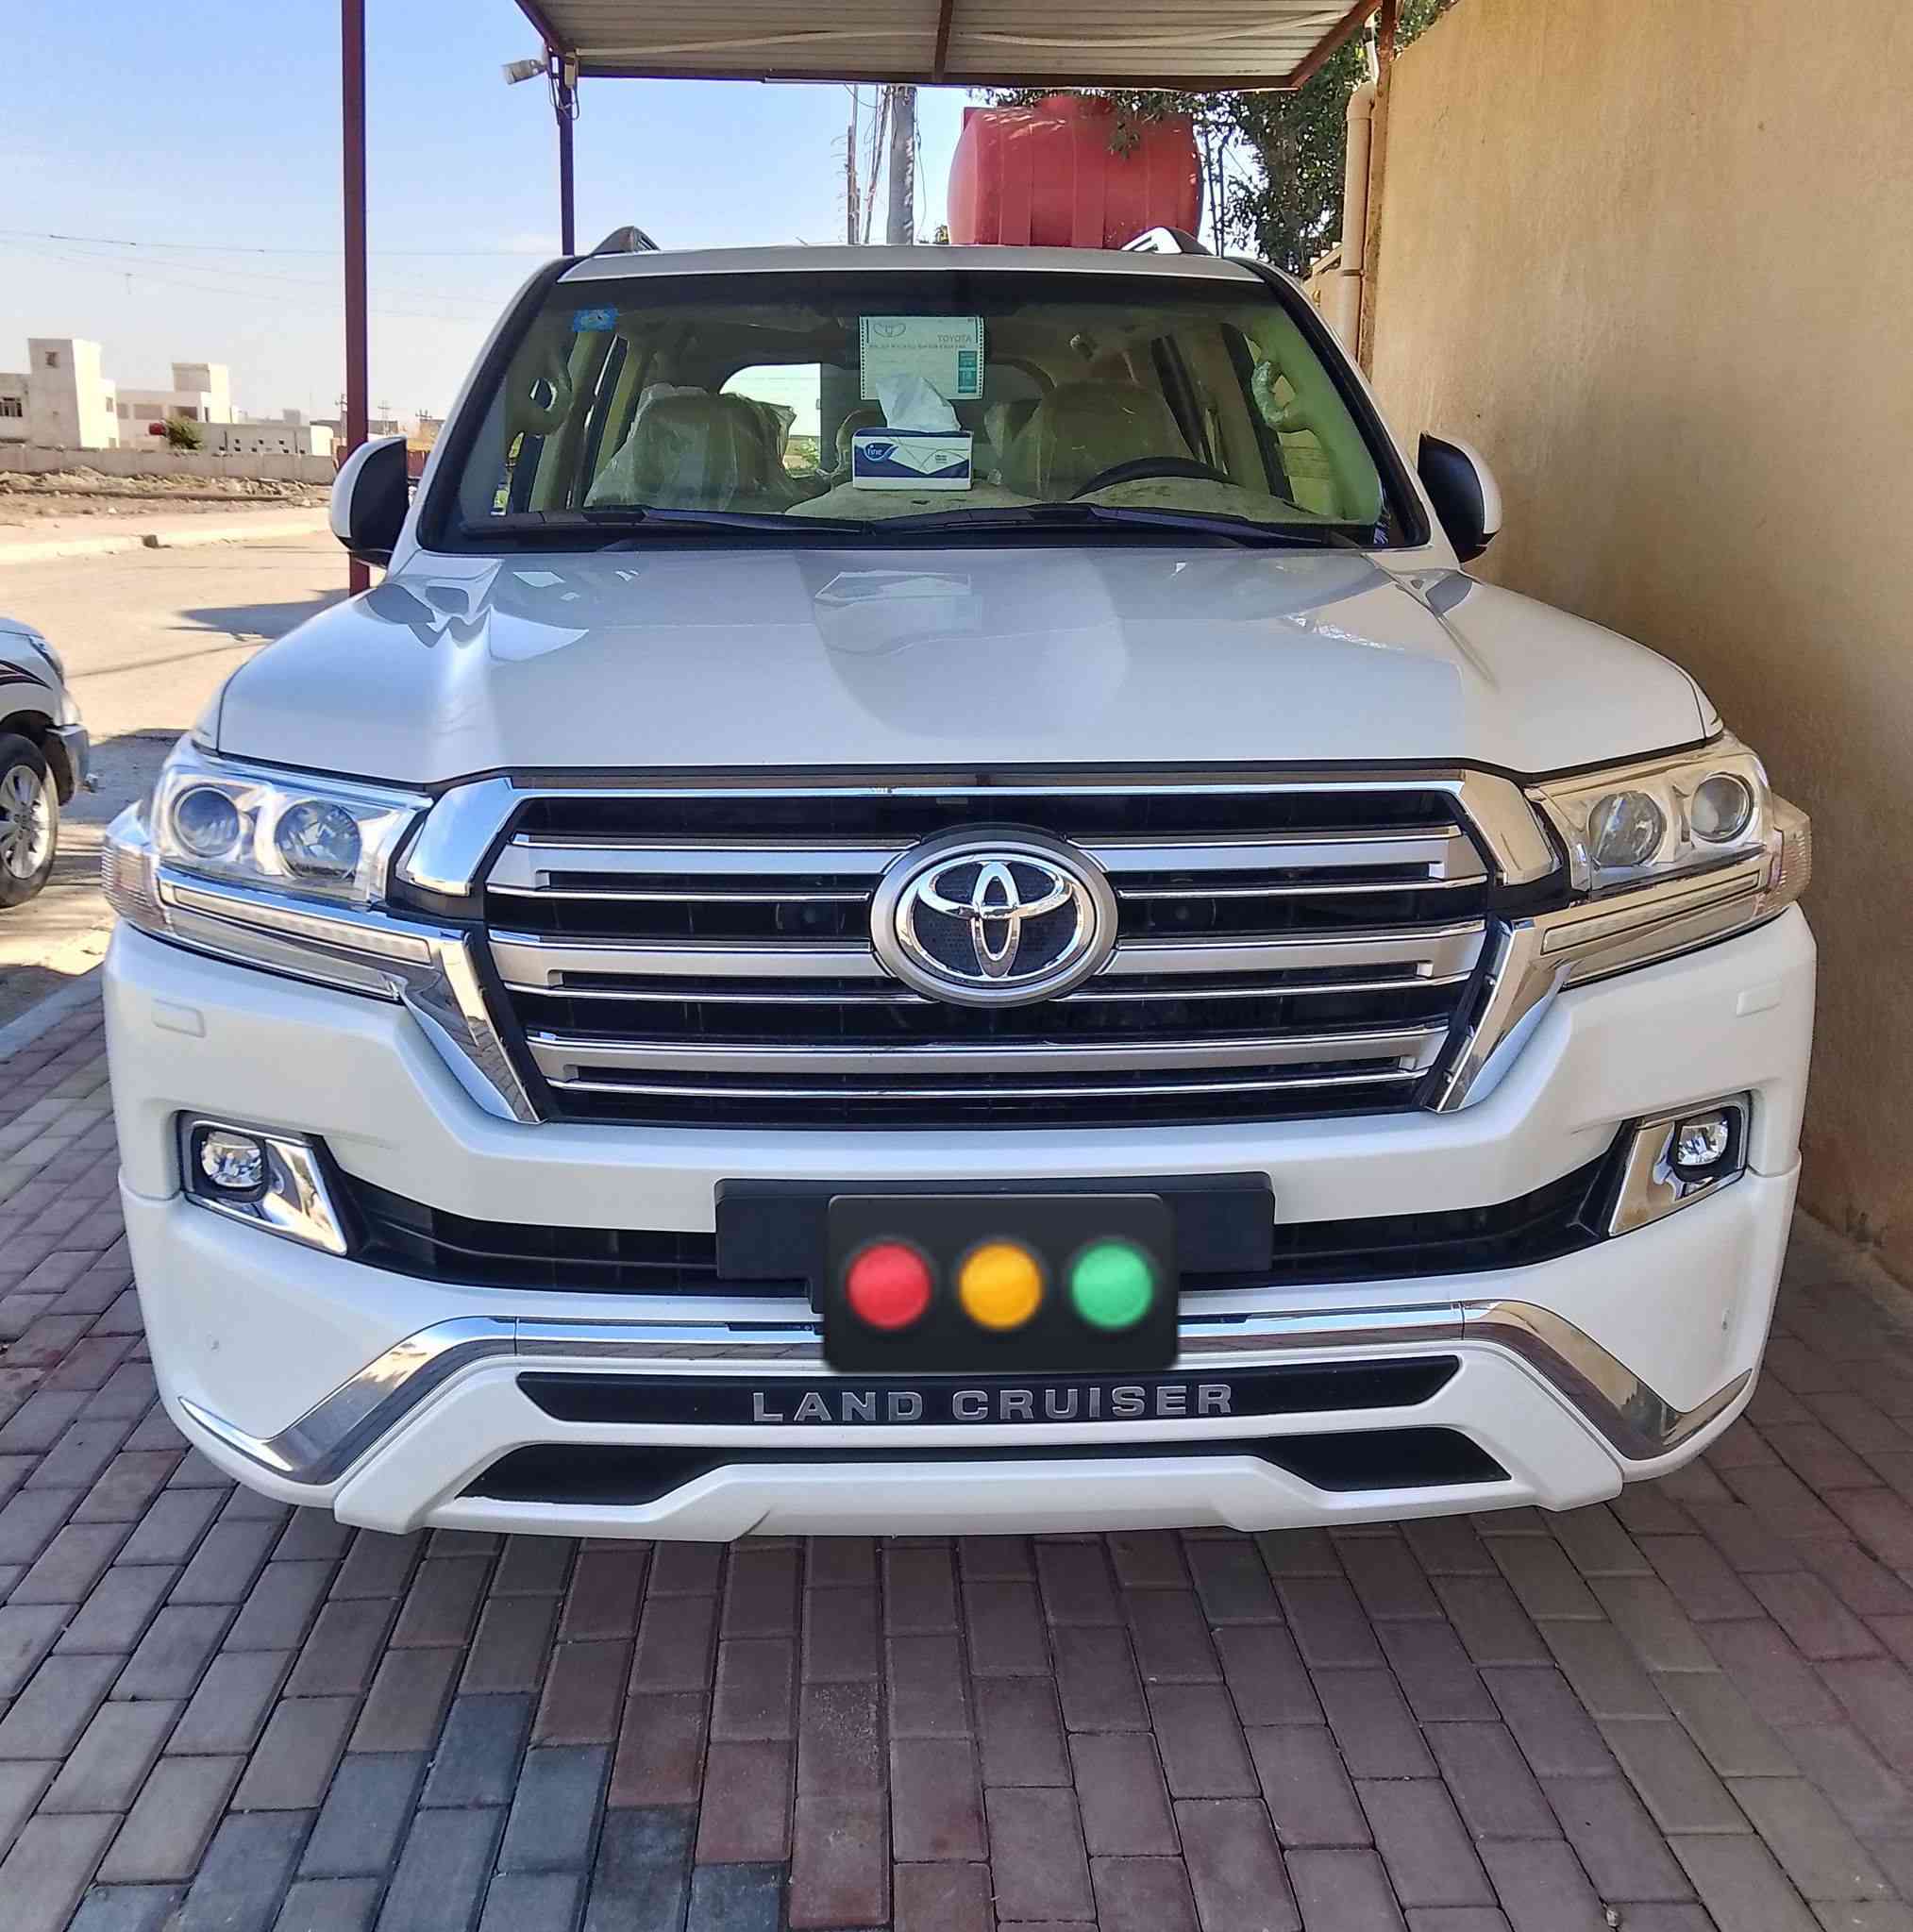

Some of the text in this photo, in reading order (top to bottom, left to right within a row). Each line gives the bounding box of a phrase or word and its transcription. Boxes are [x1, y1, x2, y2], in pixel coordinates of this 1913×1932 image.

[867, 445, 882, 456] fine
[752, 1384, 1233, 1422] LAND CRUISER
